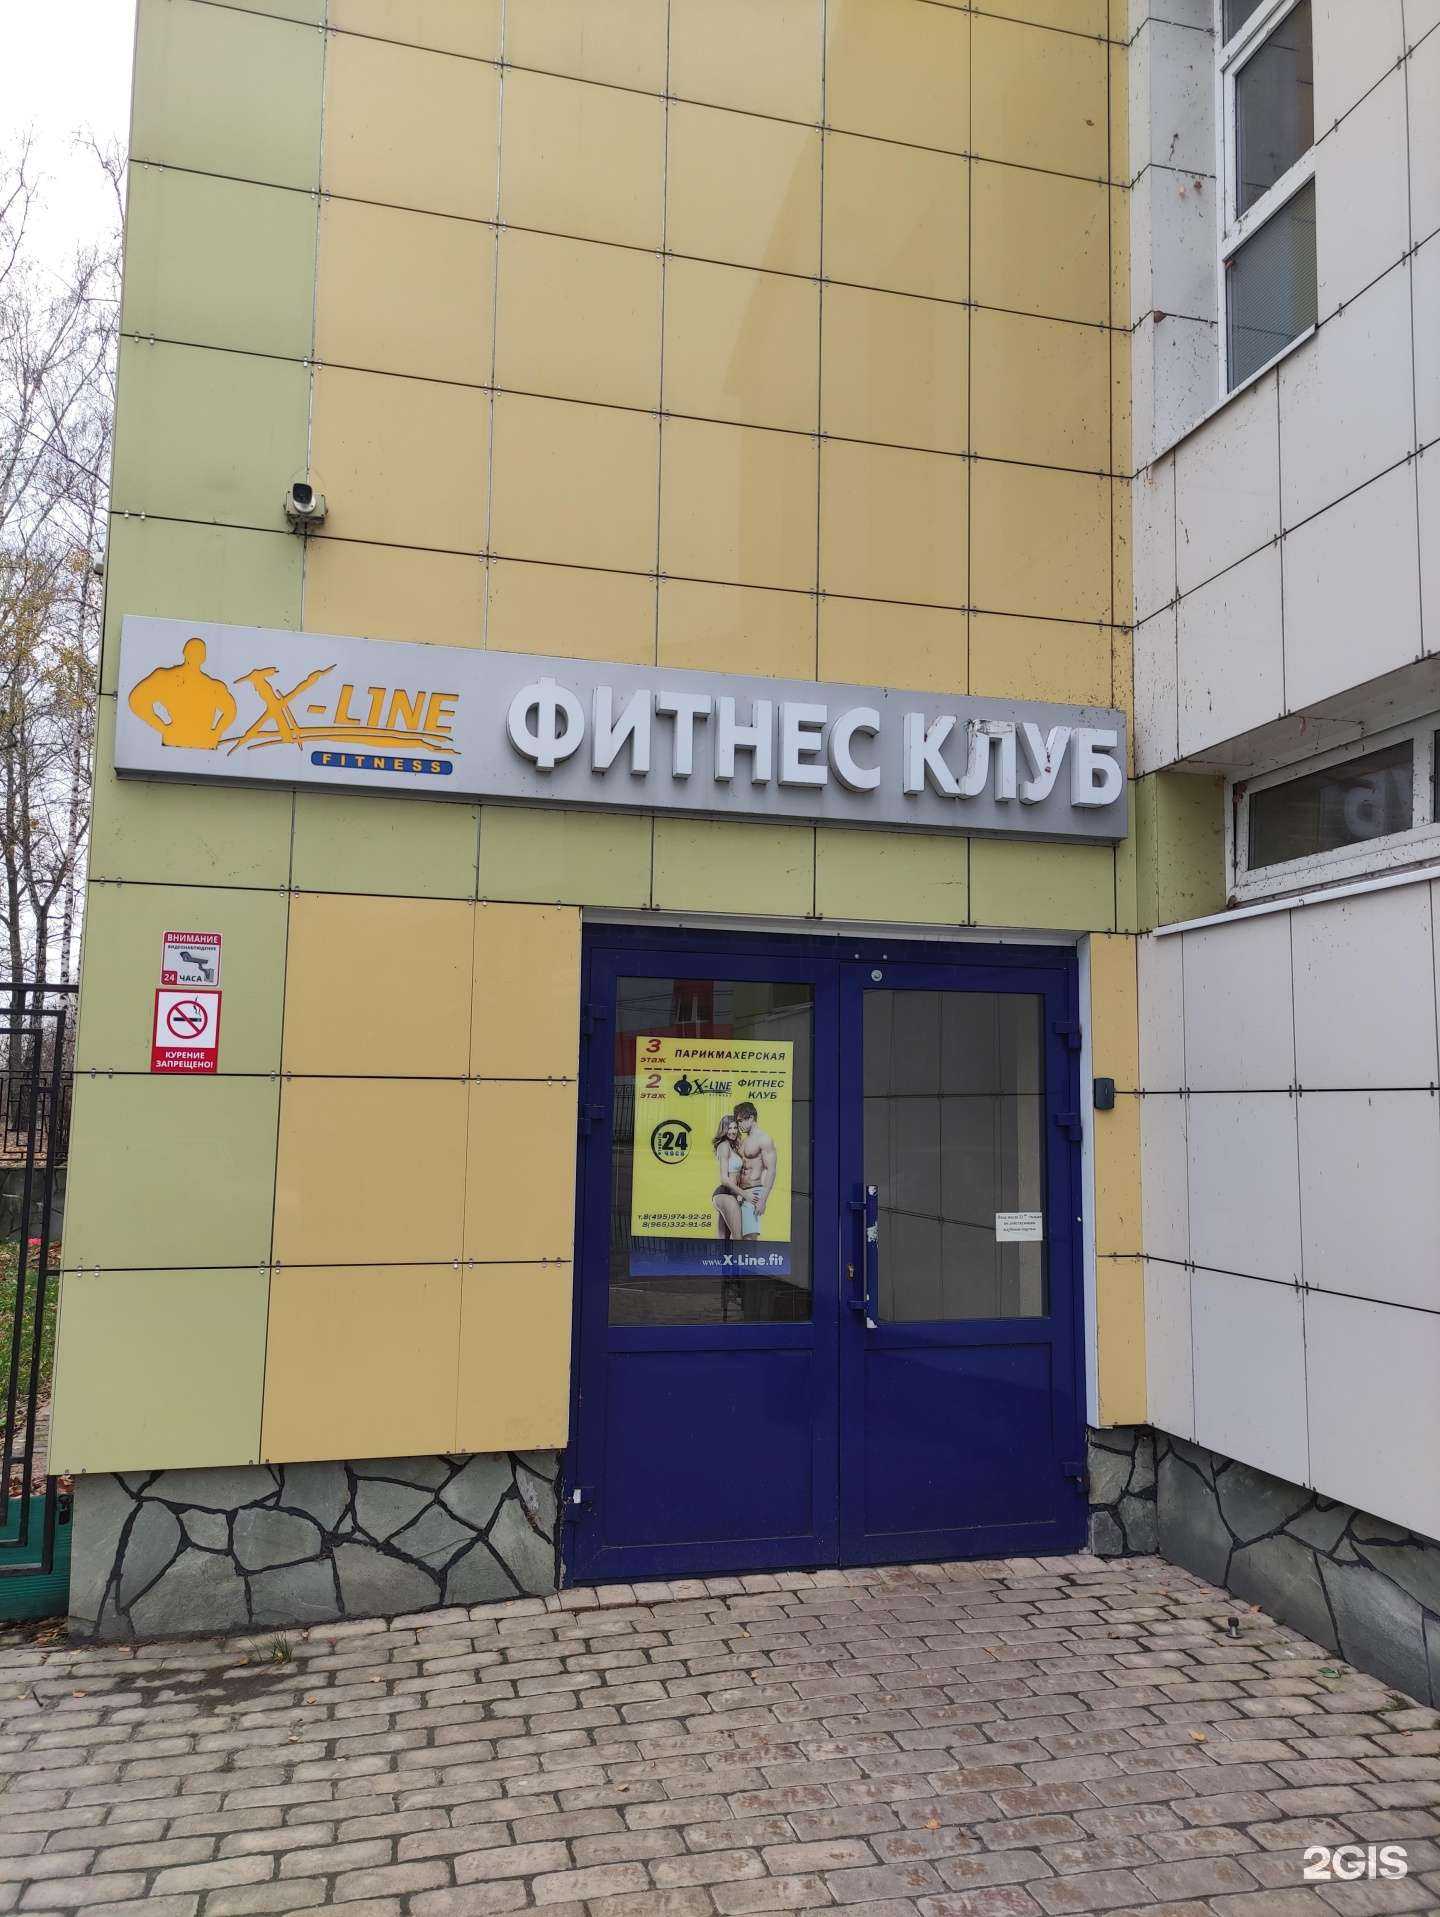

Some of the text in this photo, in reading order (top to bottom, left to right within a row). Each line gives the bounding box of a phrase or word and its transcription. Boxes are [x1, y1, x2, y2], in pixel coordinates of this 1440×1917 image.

[228, 664, 461, 755] X-LINE
[506, 676, 1123, 808] ФИТНЕС КЛУБ
[321, 753, 443, 774] FITNESS
[167, 933, 219, 944] ВНИМАНИЕ
[163, 973, 203, 983] 24 ЧАСА
[646, 1039, 662, 1053] 3
[165, 1051, 205, 1059] КУРЕНИЕ
[674, 1049, 786, 1061] ПАРИКМАХЕРСКАЯ
[155, 1060, 213, 1069] ЗАПРЕЩЕНО!
[646, 1074, 662, 1089] 2
[737, 1079, 785, 1088] ФИТНЕС
[748, 1091, 777, 1100] КЛУБ
[662, 1131, 688, 1150] 24
[702, 1253, 784, 1267] www.X-Line.fit
